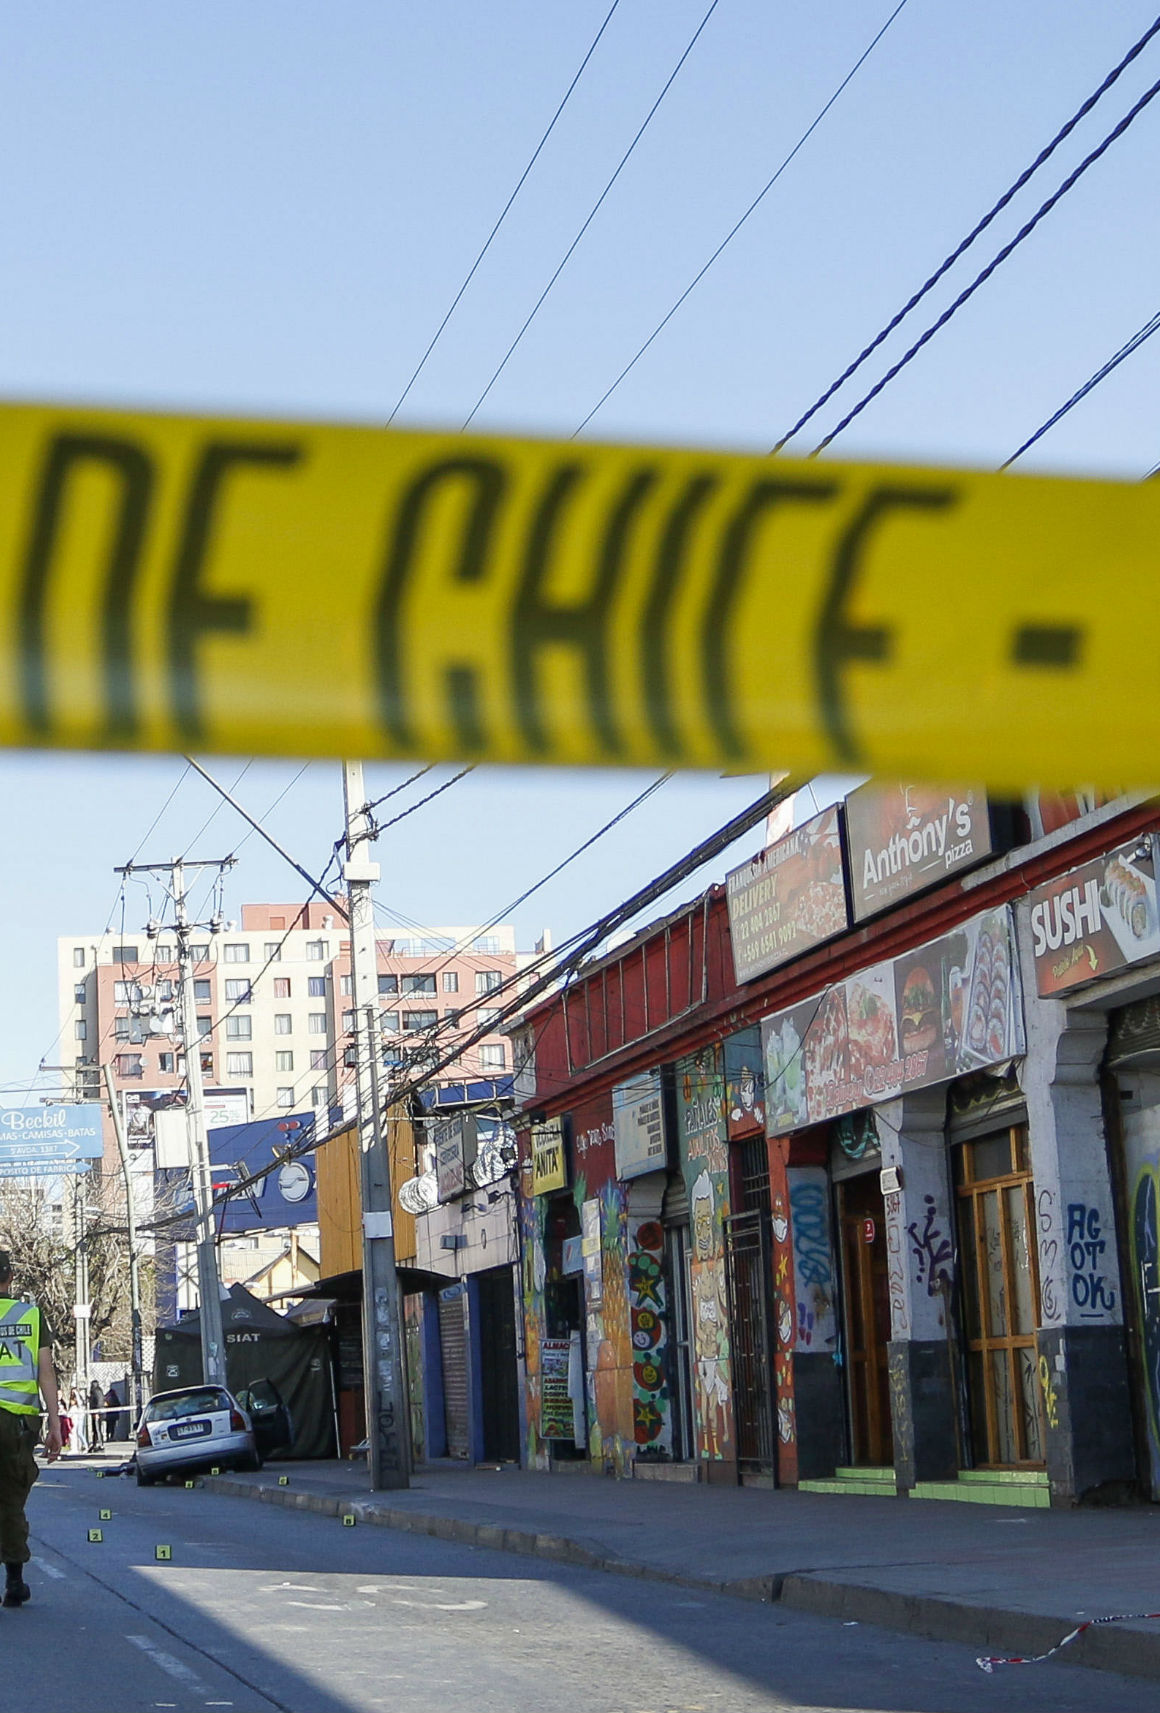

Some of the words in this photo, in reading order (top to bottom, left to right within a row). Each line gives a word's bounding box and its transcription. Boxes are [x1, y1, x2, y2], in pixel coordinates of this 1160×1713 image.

[862, 797, 972, 890] Anthony's
[944, 838, 974, 870] pizza
[731, 873, 779, 922] DELIVERY
[1031, 878, 1102, 958] SUSHI
[741, 921, 750, 941] 22
[1, 1109, 67, 1130] Beckil
[211, 1110, 229, 1124] 25
[30, 1166, 42, 1175] DE
[8, 1325, 16, 1335] DE
[16, 1324, 31, 1335] CHILE
[226, 1333, 261, 1343] SIAT
[543, 1341, 570, 1350] ALMAC
